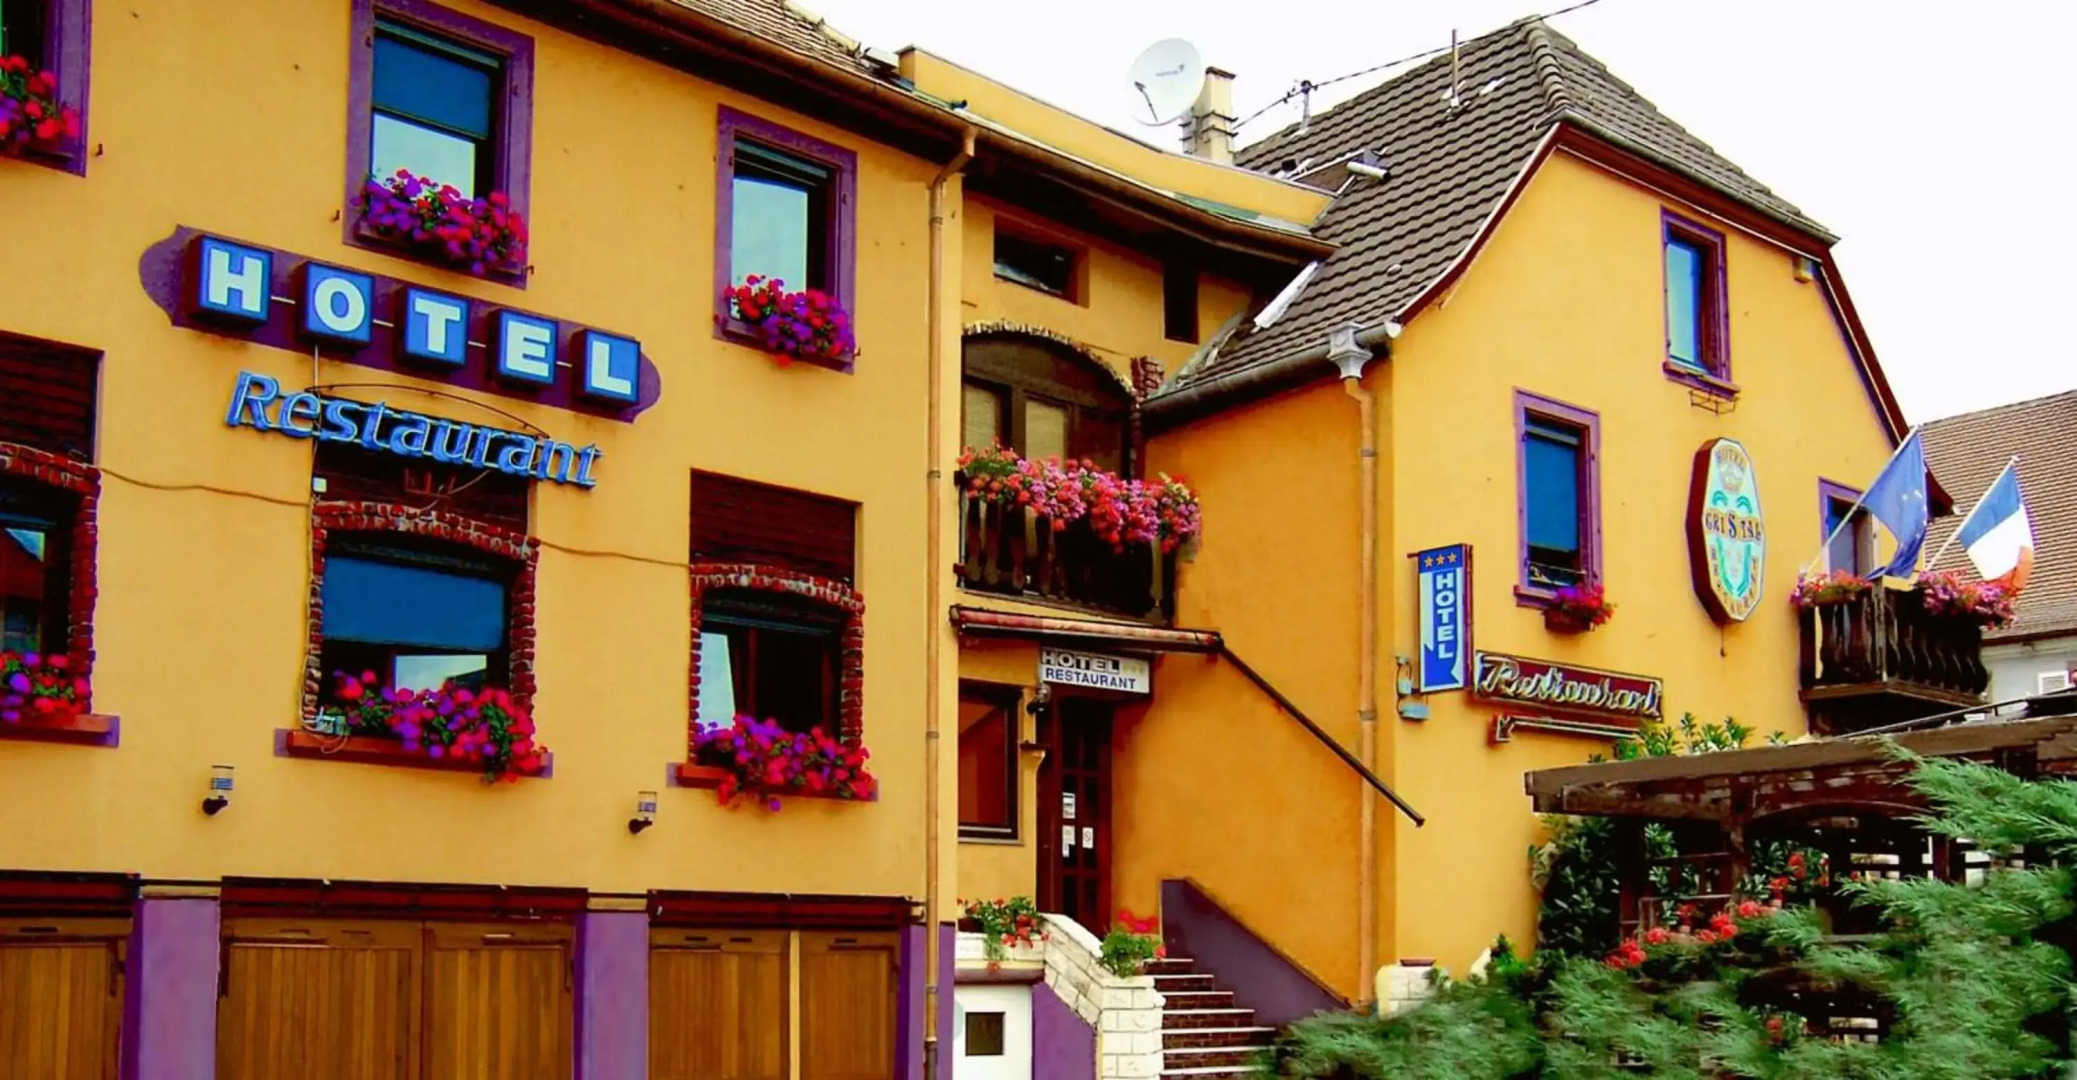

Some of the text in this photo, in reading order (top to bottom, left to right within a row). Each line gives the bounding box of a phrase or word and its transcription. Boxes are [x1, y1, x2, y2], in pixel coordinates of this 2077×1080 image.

[206, 247, 634, 396] HOTEL
[225, 370, 604, 490] Restaurant
[1435, 573, 1455, 659] HOTEL
[1042, 650, 1120, 674] HOTEL
[1046, 668, 1136, 690] RESTAURANT
[1480, 655, 1662, 718] Restaurant
